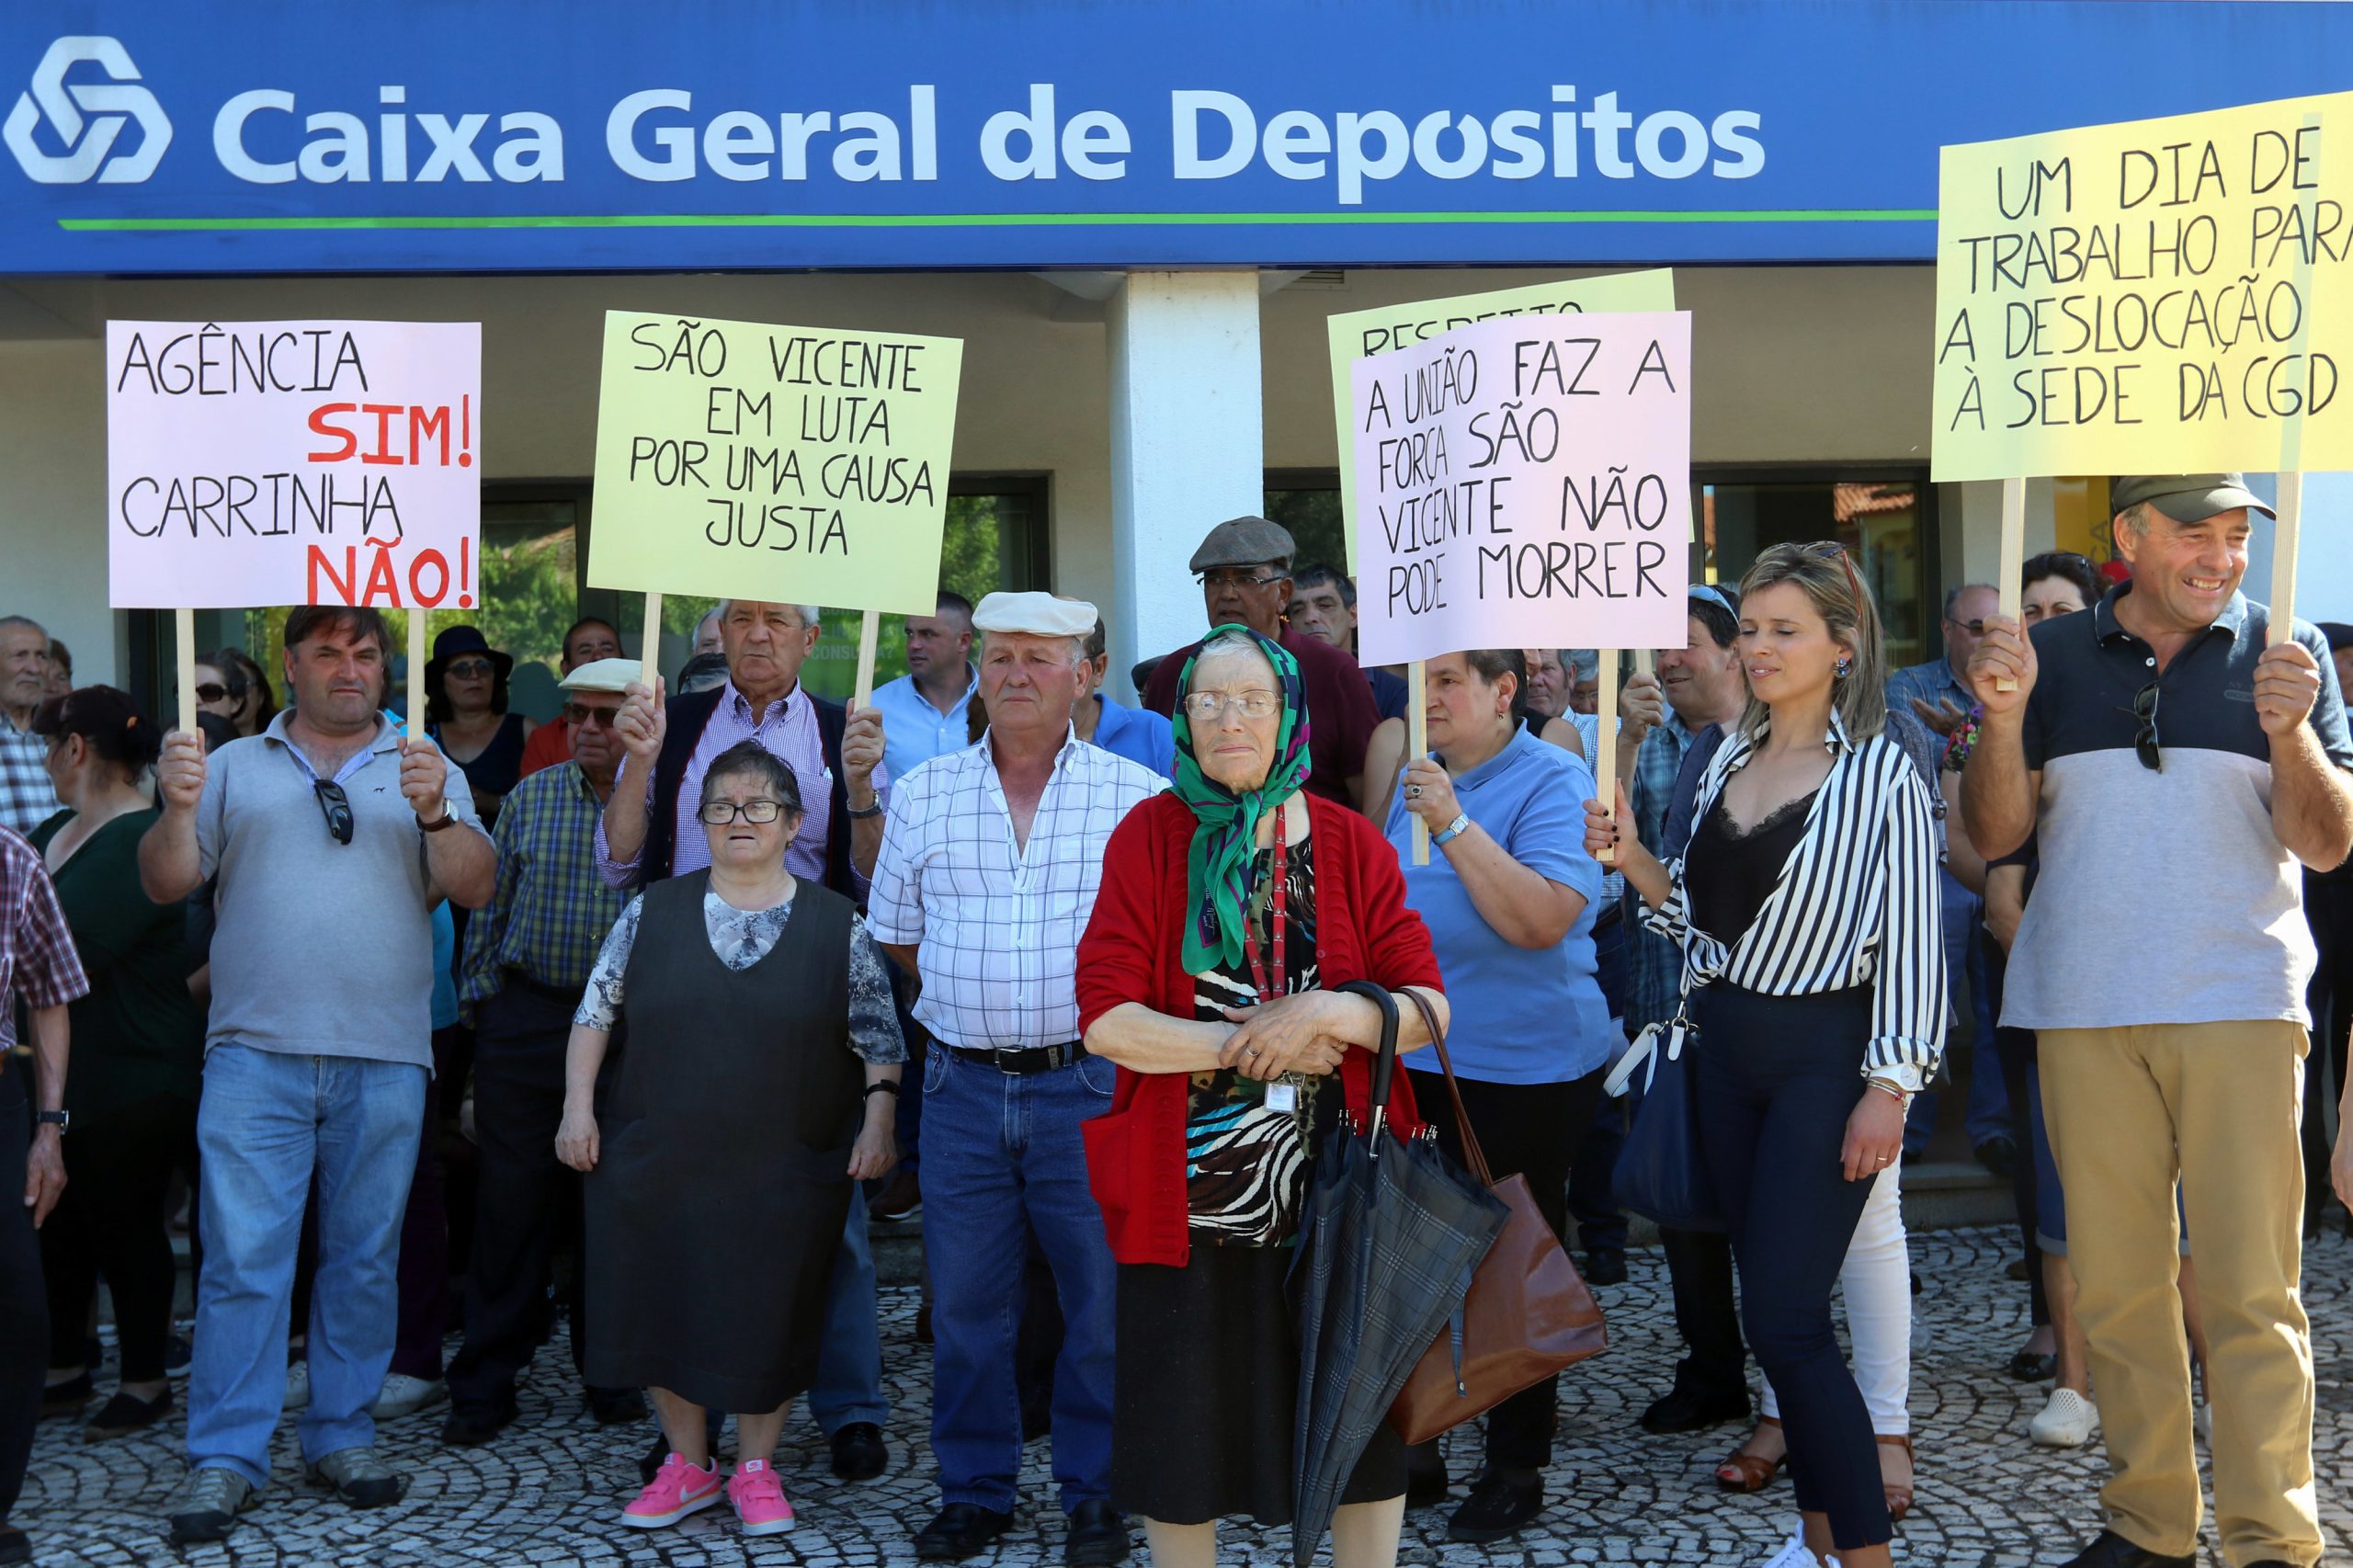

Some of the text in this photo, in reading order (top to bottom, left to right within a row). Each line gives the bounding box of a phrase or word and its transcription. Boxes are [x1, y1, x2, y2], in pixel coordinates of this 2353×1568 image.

[214, 86, 563, 183] Caixa
[607, 85, 937, 181] Geral
[981, 84, 1131, 180] de
[1998, 126, 2320, 220] UM DIA DE
[1959, 214, 2217, 294] TRABALHO
[1939, 272, 2302, 364] A DESLOCAÇÃO
[118, 325, 368, 395] AGÊNCIA
[631, 321, 925, 392] SÃO VICENTE
[1366, 338, 1676, 433] A UNIÃO FAZ A
[1950, 353, 2337, 431] À SEDE DA CGD
[309, 395, 471, 467] SIM!
[708, 387, 889, 446] EM LUTA
[1380, 401, 1559, 493] FORÇA SÃO
[121, 473, 404, 537] CARRINHA
[631, 437, 933, 507] POR UMA CAUSA
[1379, 465, 1667, 553] VICENTE NÃO
[706, 499, 847, 555] JUSTA
[308, 537, 472, 608] NÃO!
[1389, 541, 1667, 618] PODE MORRER
[812, 645, 894, 660] CONSUA?
